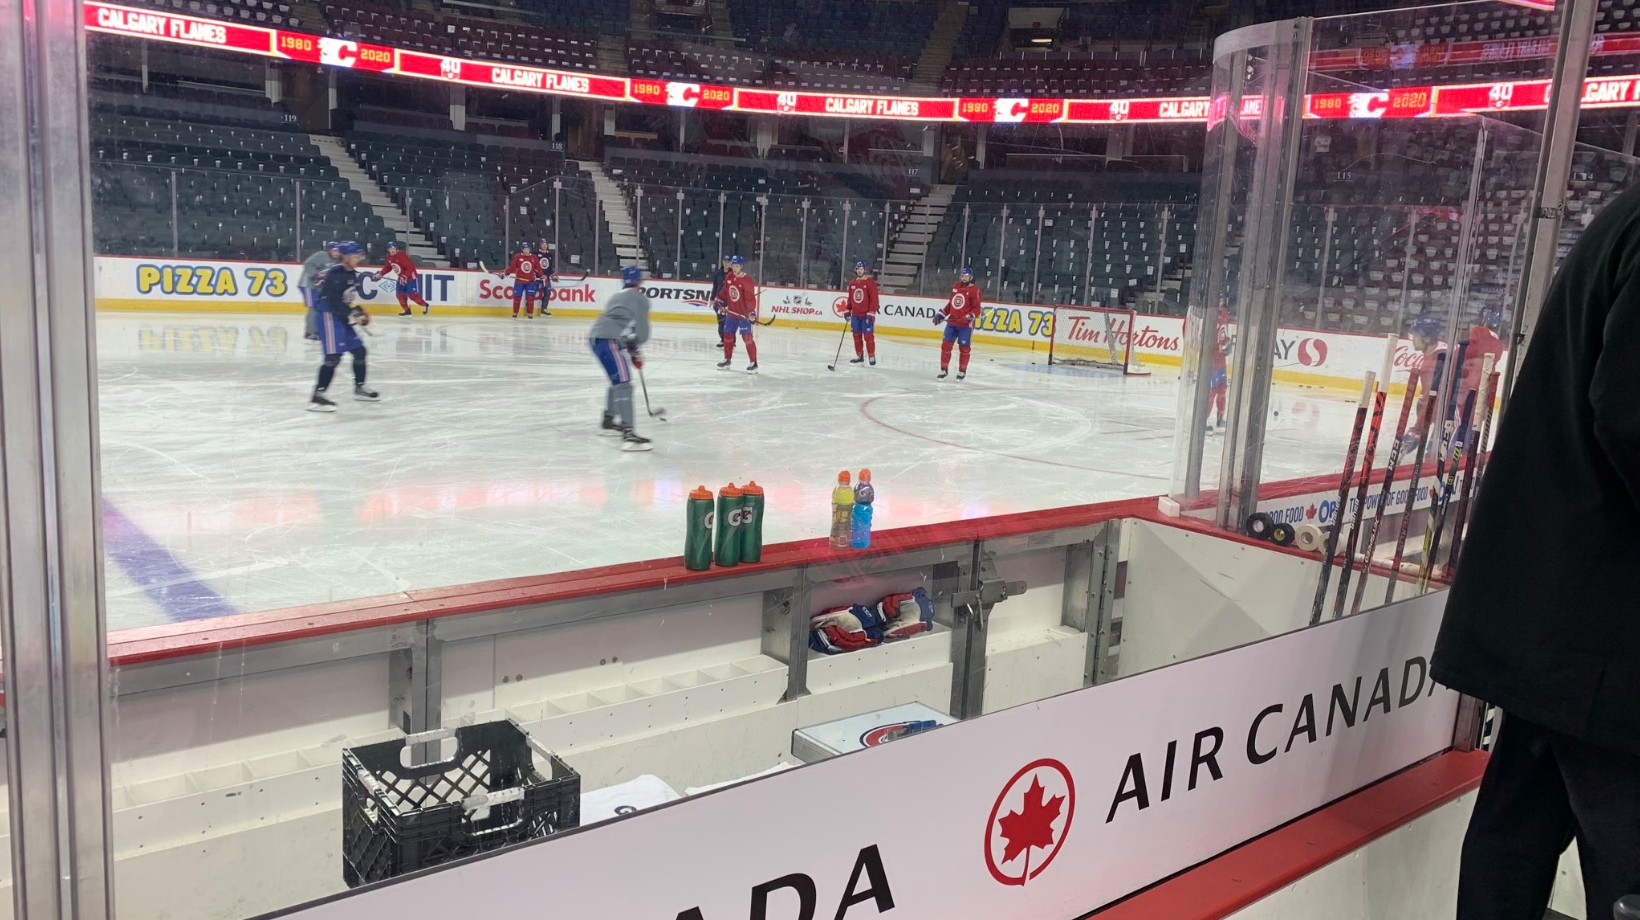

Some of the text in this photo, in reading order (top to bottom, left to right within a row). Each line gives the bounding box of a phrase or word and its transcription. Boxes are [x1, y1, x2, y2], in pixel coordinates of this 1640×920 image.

[98, 9, 227, 44] CALGARY FLAMES
[281, 36, 312, 51] 1980
[360, 48, 391, 63] 2020
[440, 58, 461, 73] 40
[491, 67, 590, 93] CALGARY FLAMES
[634, 83, 660, 95] 1980
[703, 89, 730, 101] 2020
[777, 93, 797, 106] 40
[1314, 98, 1342, 109] 1980
[1392, 91, 1427, 109] 2020
[1489, 84, 1514, 100] 40
[825, 98, 919, 117] CALGARY FLAMES
[962, 102, 989, 113] 1980
[1031, 102, 1060, 113] 2020
[1109, 101, 1129, 114] 40
[1158, 101, 1210, 117] CALGARY
[284, 114, 297, 122] 119
[136, 264, 288, 297] PIZZA 73
[479, 279, 596, 303] Scobank
[884, 304, 936, 319] CANAD
[1028, 310, 1054, 337] 73
[1068, 316, 1180, 351] Tim Hortons
[1285, 507, 1304, 523] FOOD
[1105, 655, 1452, 824] AIR CANAD
